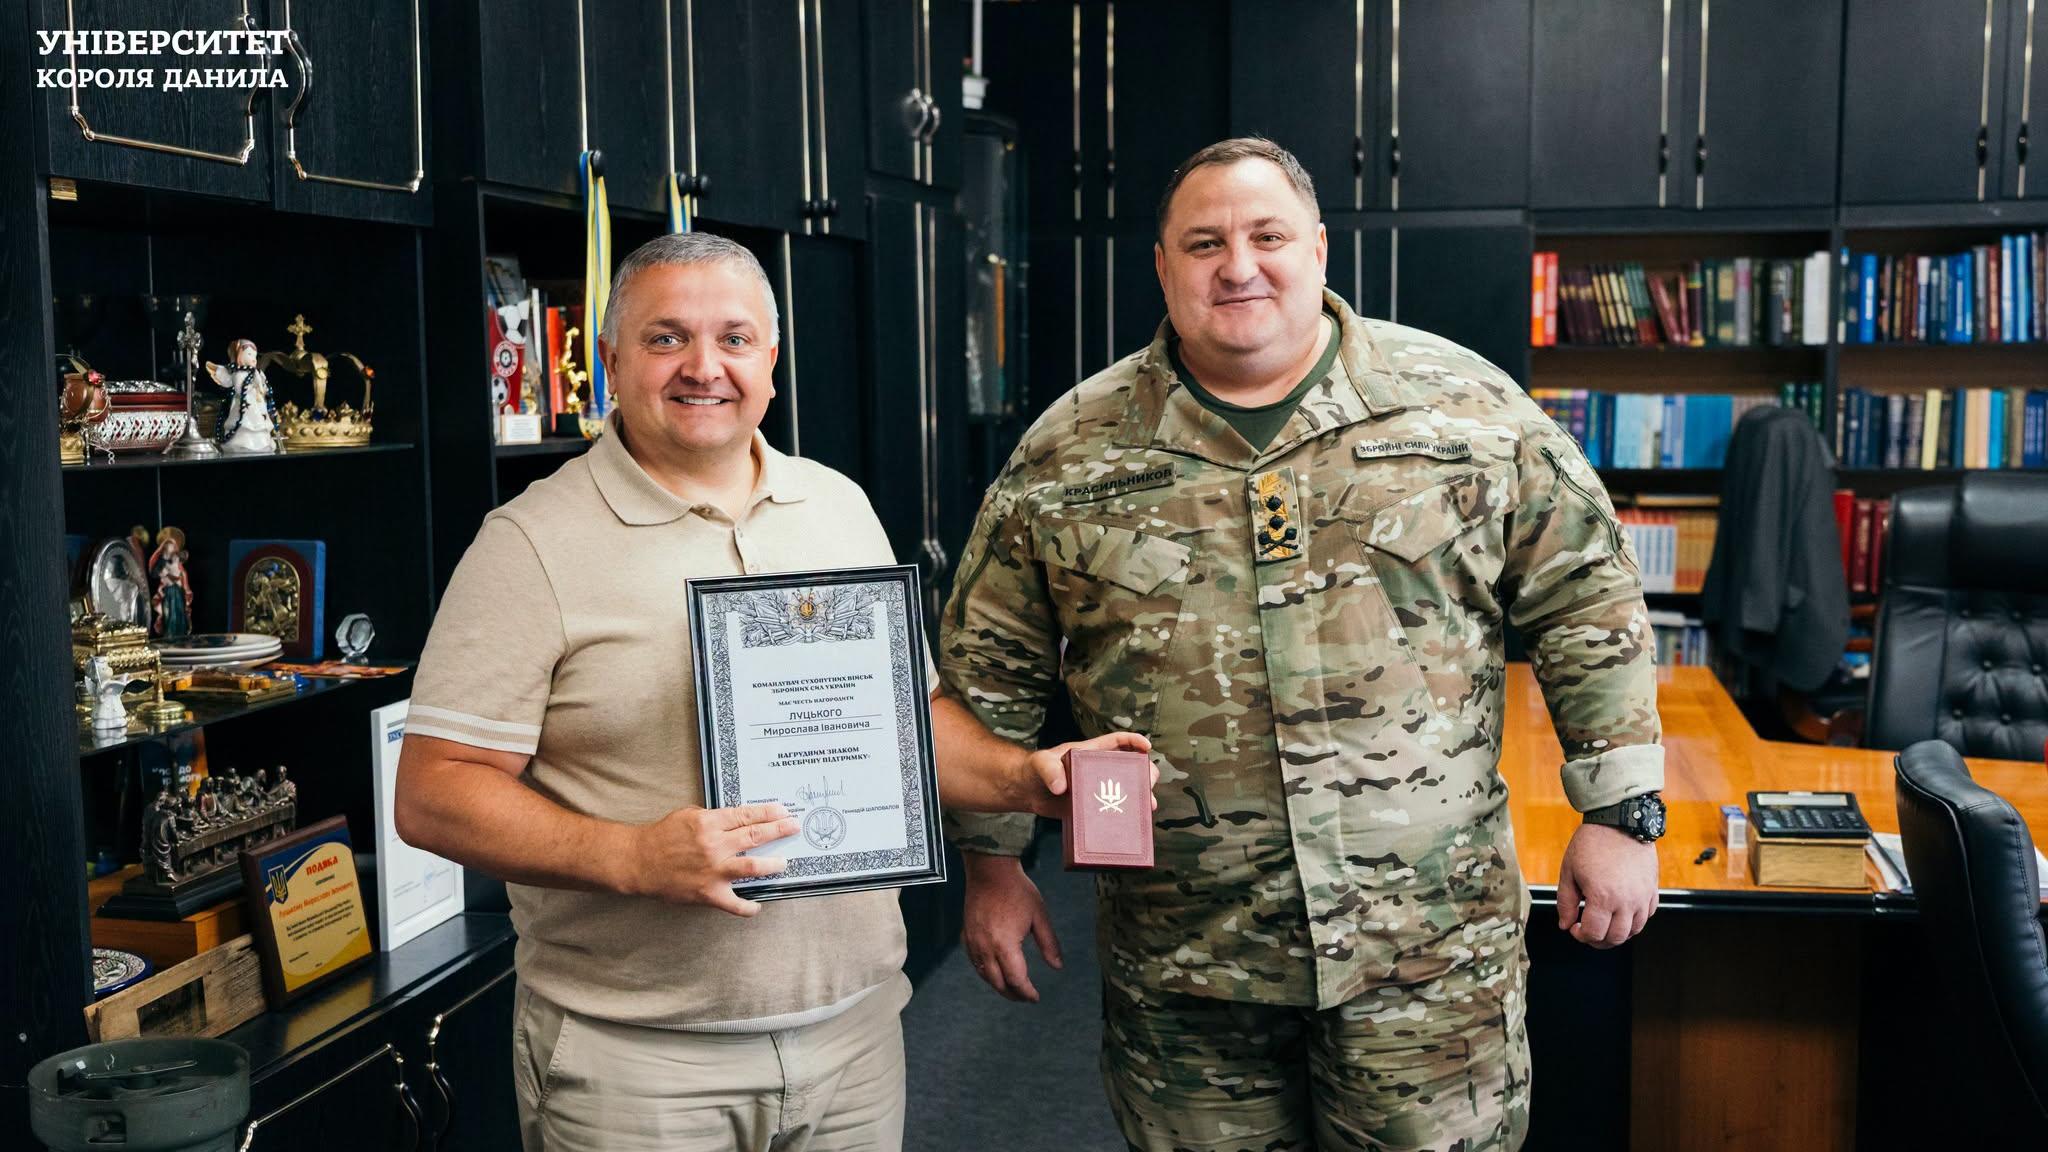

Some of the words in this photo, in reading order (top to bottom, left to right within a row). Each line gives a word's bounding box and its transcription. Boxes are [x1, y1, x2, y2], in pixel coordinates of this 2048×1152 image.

[1360, 443, 1402, 453] ЗБРОЙНІ
[1404, 441, 1429, 449] СИЛИ
[1431, 443, 1469, 454] УКРАЇНИ
[1065, 468, 1172, 496] КРАСИЛЬНИКОВ
[752, 680, 799, 689] КОМАНДУВАЧ
[789, 708, 842, 721] ЛУЦЬКОГО
[763, 724, 819, 737] Мирослава
[821, 720, 870, 732] Івановича
[777, 750, 825, 759] НАГРУДНИМ
[826, 746, 859, 755] ЗНАКОМ
[306, 856, 338, 876] ПОДЯКА
